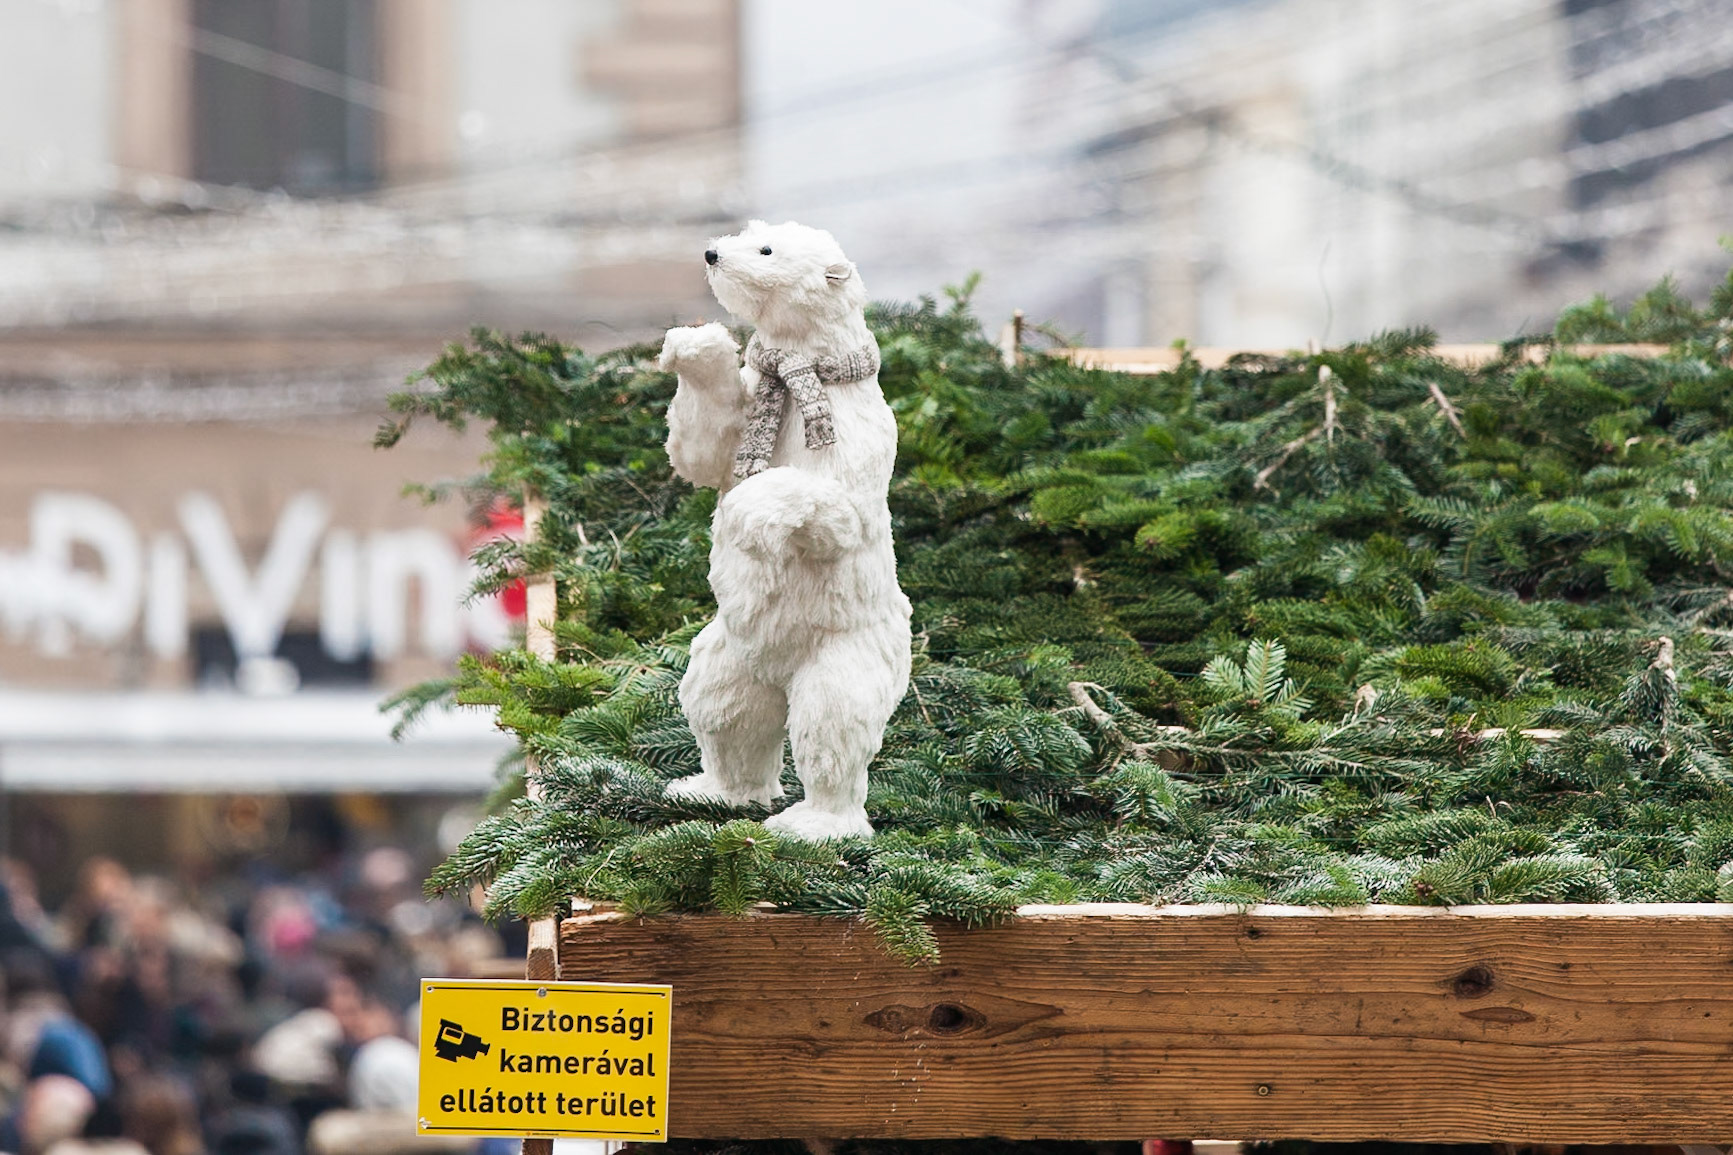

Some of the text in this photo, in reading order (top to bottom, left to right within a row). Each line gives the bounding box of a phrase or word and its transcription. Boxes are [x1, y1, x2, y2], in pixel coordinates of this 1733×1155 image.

[501, 1007, 653, 1041] Biztonsági
[499, 1048, 656, 1077] kamerával
[439, 1087, 656, 1118] ellátott terület
